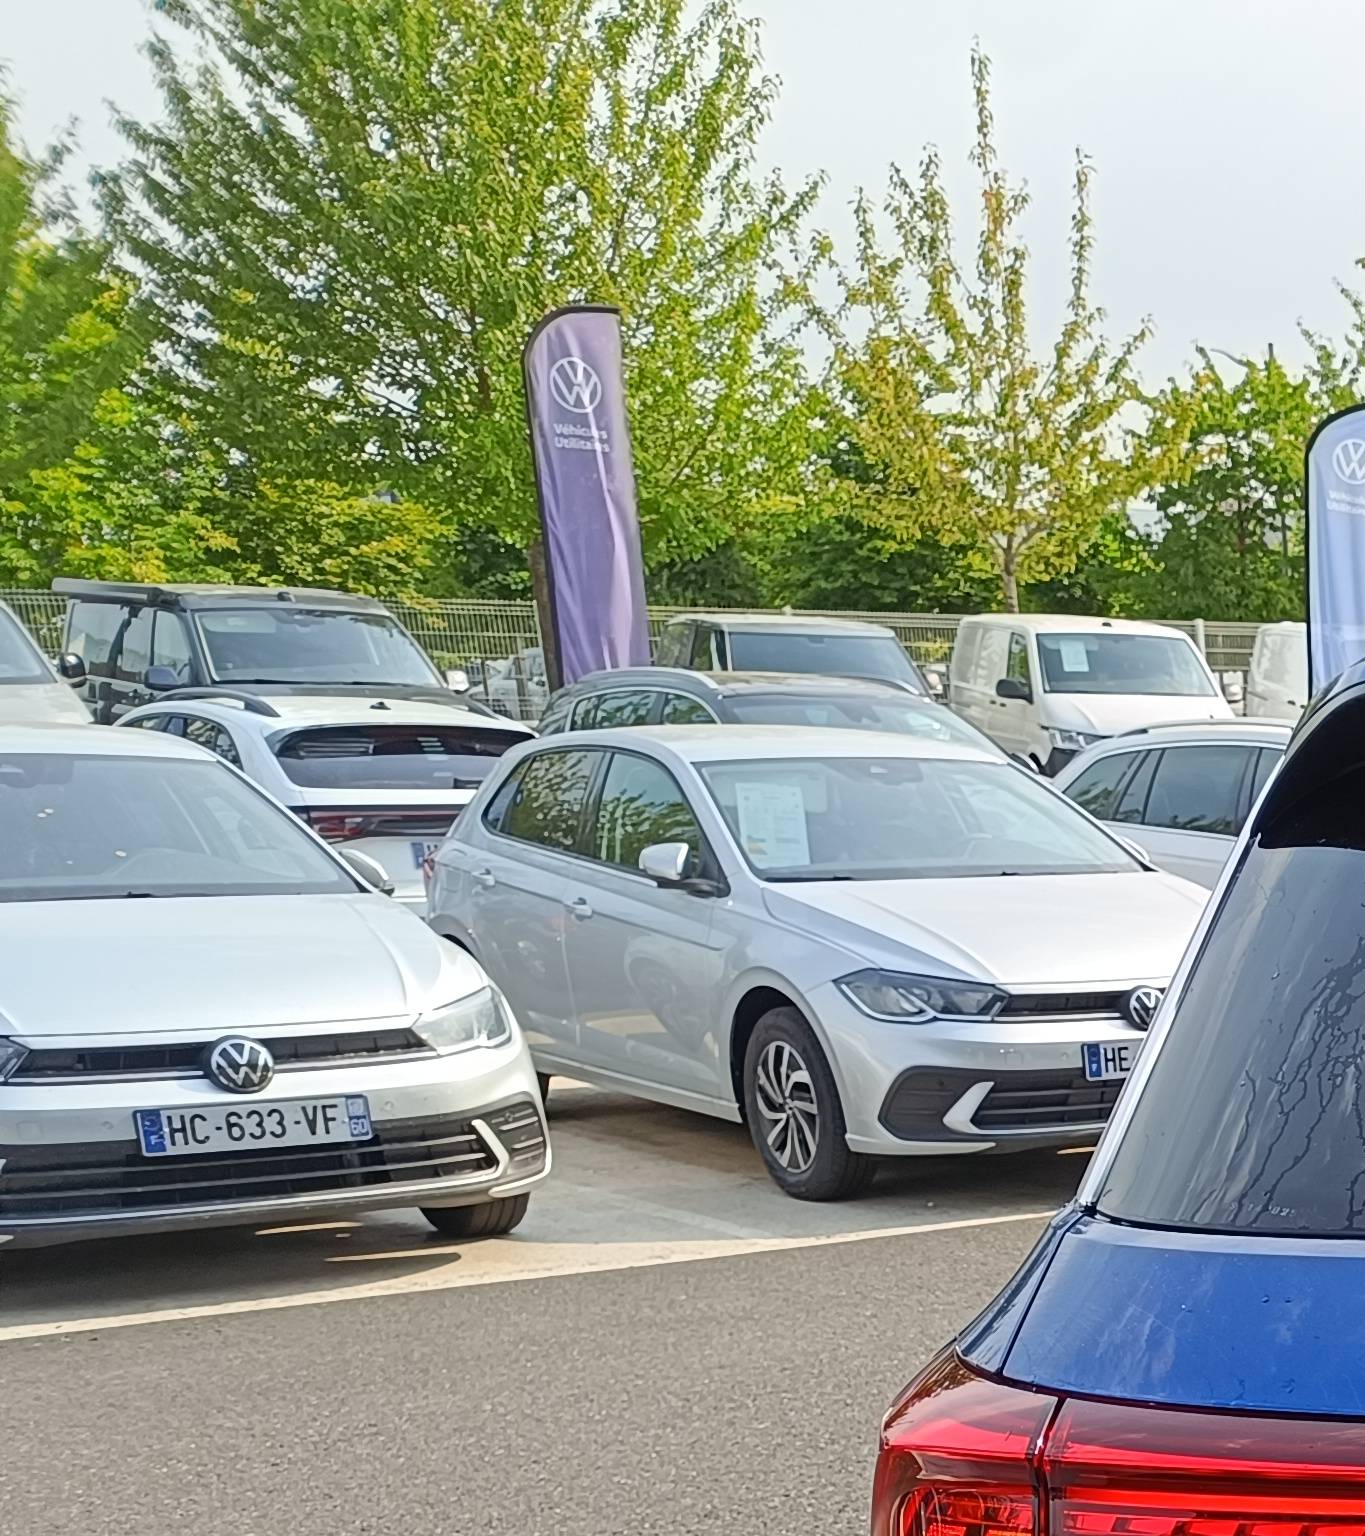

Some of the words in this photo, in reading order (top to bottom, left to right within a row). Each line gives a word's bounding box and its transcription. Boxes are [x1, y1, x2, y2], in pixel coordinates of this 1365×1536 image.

[550, 357, 602, 413] VW
[553, 423, 608, 439] Véhicus
[211, 1038, 274, 1092] VW
[166, 1103, 339, 1147] HC-633-VF
